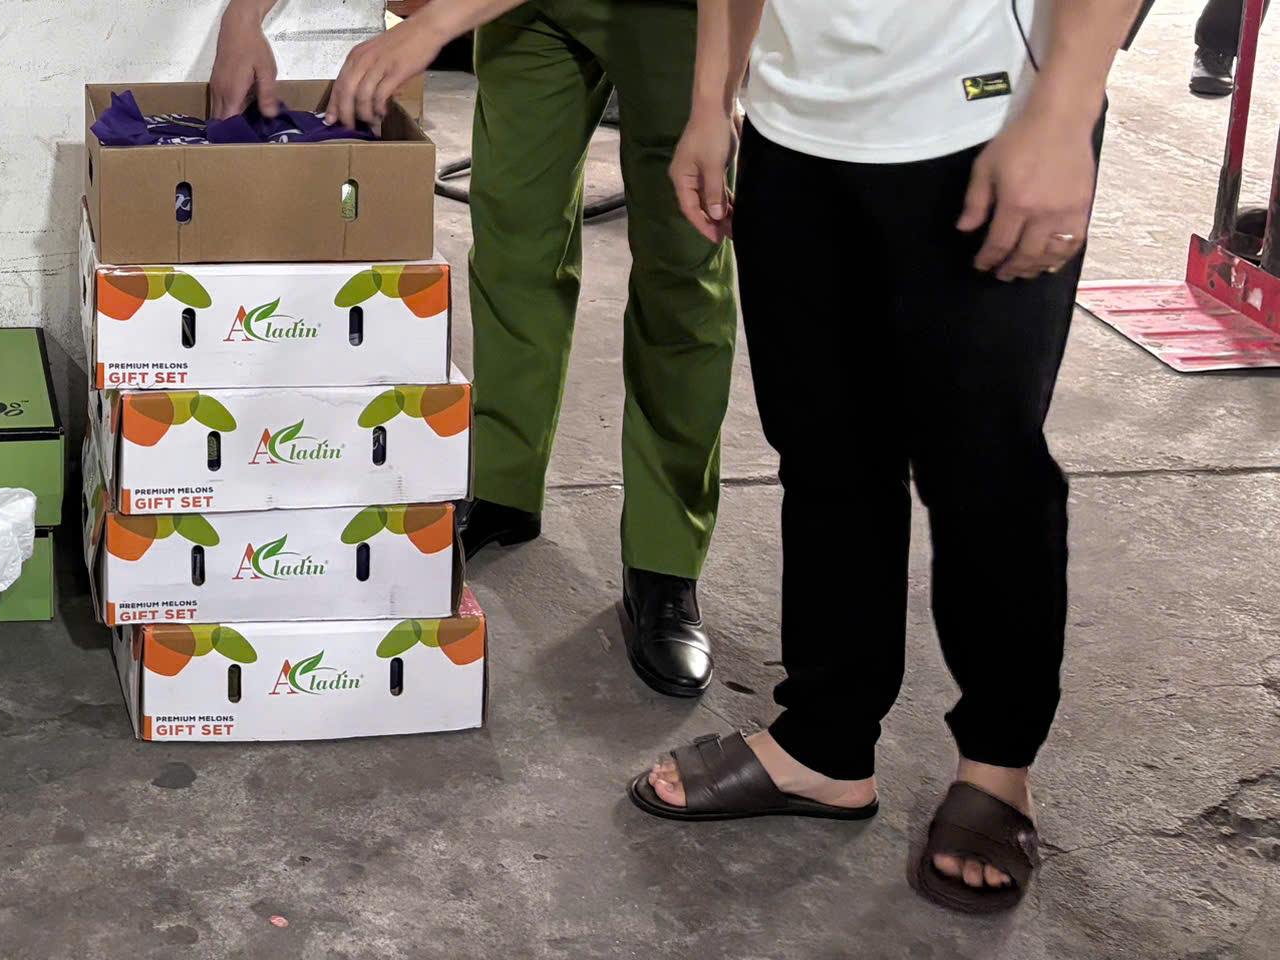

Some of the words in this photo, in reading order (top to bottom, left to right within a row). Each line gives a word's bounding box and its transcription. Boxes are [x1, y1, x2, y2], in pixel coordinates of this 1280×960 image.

[108, 372, 149, 384] GIFT
[154, 372, 188, 384] SET
[177, 486, 214, 494] MELONS
[135, 497, 175, 509] GIFT
[180, 496, 214, 508] SET
[119, 601, 160, 609] PREMIUM
[119, 610, 159, 622] GIFT
[164, 608, 197, 620] SET
[155, 715, 196, 723] PREMIUM
[156, 724, 196, 736] GIFT
[201, 724, 234, 736] SET
